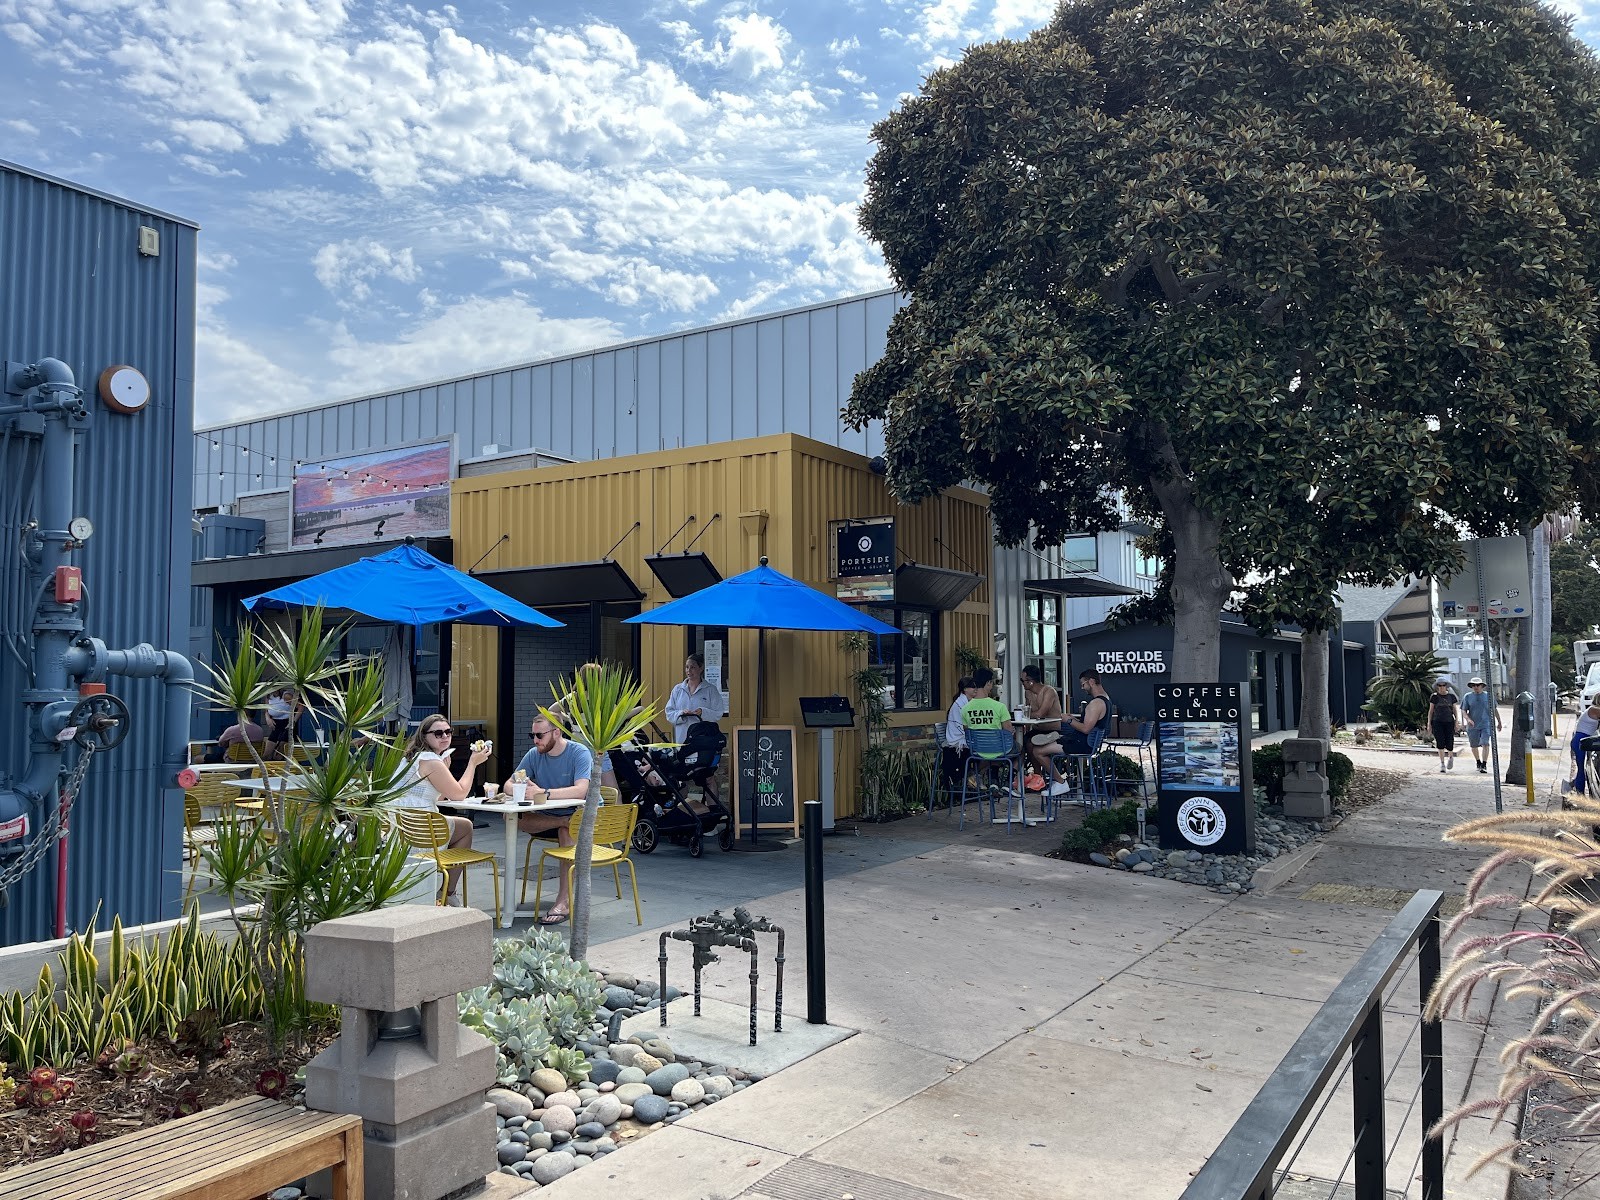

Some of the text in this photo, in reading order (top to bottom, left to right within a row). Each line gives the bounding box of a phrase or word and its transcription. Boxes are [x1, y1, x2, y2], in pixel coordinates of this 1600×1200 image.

[841, 556, 890, 565] PORTSIDE
[1097, 650, 1163, 662] THE OLDE
[1095, 662, 1167, 674] BOATYARD
[1158, 687, 1236, 698] COFFEE
[1192, 697, 1202, 708] &
[1158, 708, 1238, 718] GELATO
[743, 750, 784, 761] SKP THE
[757, 760, 774, 769] INE
[772, 768, 780, 776] AT
[757, 783, 775, 793] NEW
[757, 793, 783, 806] IOSK
[1179, 798, 1225, 837] JEFF BROWN YACHTS
